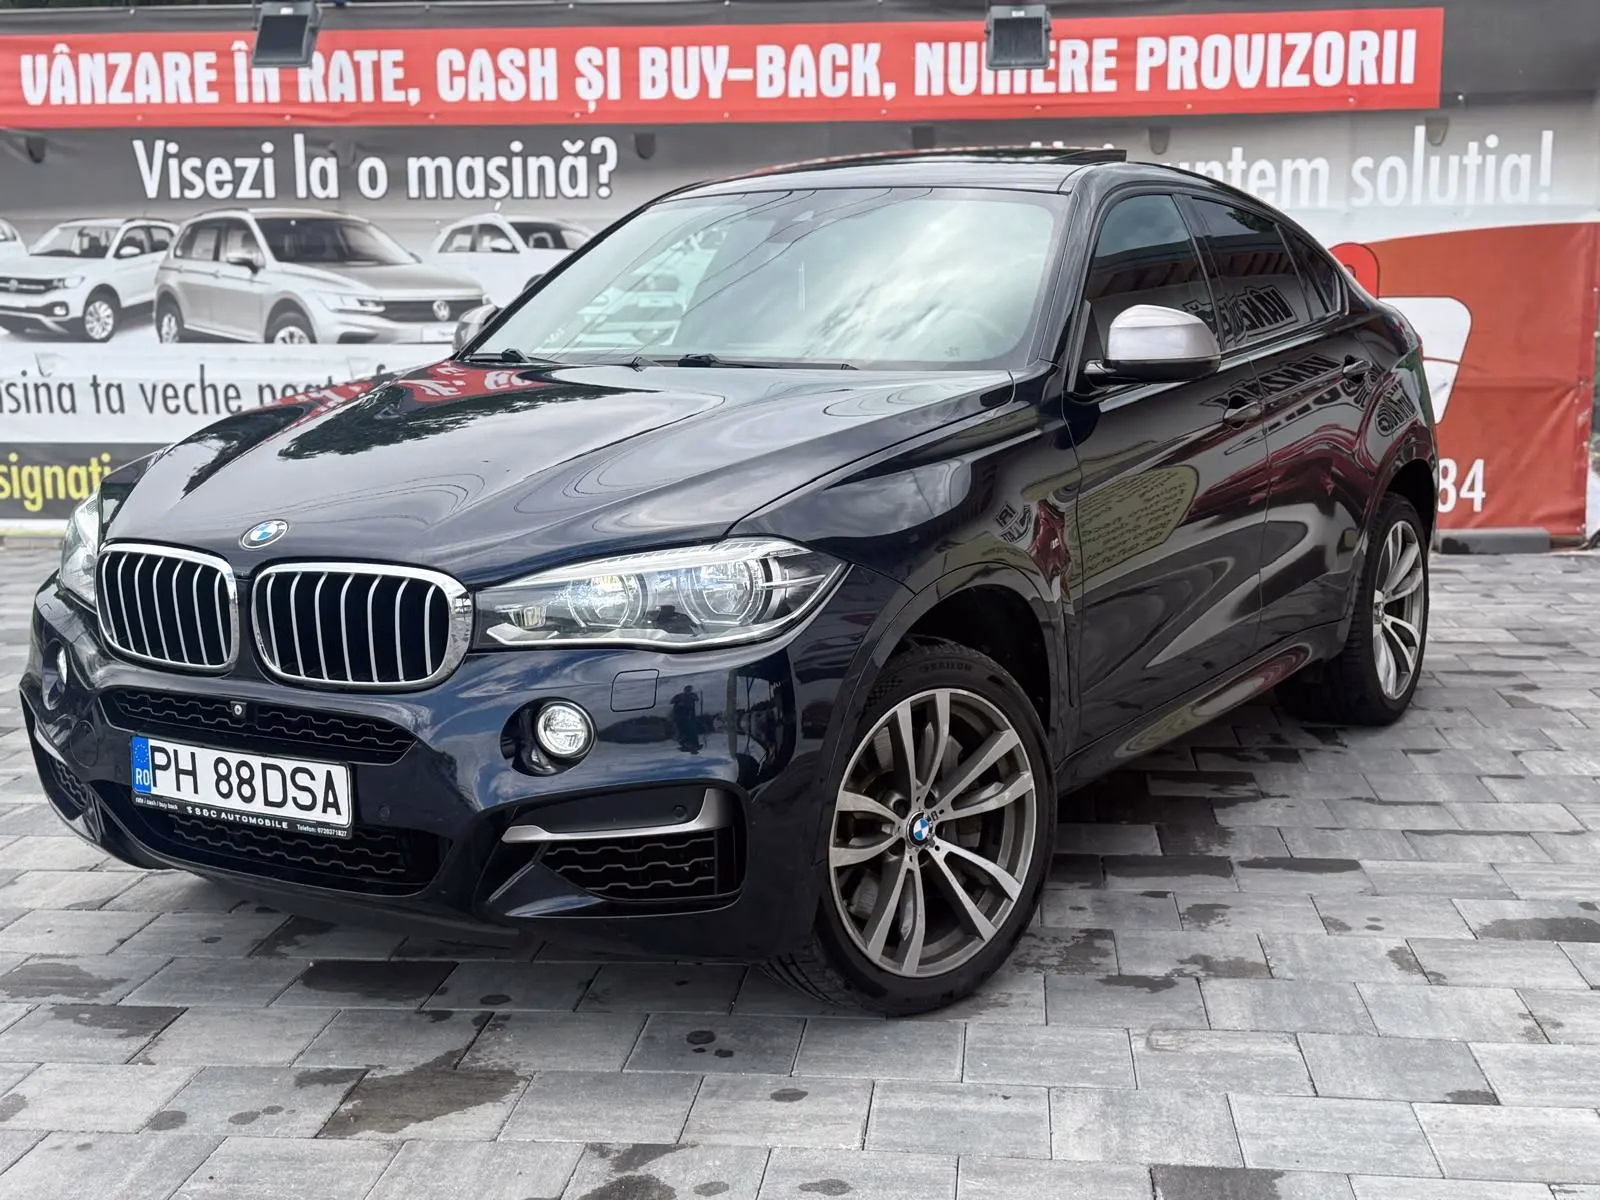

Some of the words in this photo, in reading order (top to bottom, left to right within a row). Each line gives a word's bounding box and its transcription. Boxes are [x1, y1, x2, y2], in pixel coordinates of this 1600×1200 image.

[20, 43, 219, 105] VÂNZARE
[297, 49, 421, 106] RATE,
[436, 47, 558, 102] CASH
[574, 46, 622, 114] ȘI
[1135, 29, 1417, 92] PROVIZORII
[132, 139, 276, 200] Visezi
[293, 133, 339, 199] la
[357, 156, 389, 200] o
[0, 369, 77, 415] sina
[90, 374, 126, 415] ta
[140, 364, 243, 415] veche
[135, 767, 150, 786] RO
[150, 744, 199, 795] PH
[220, 812, 288, 829] AUTOMOBILE
